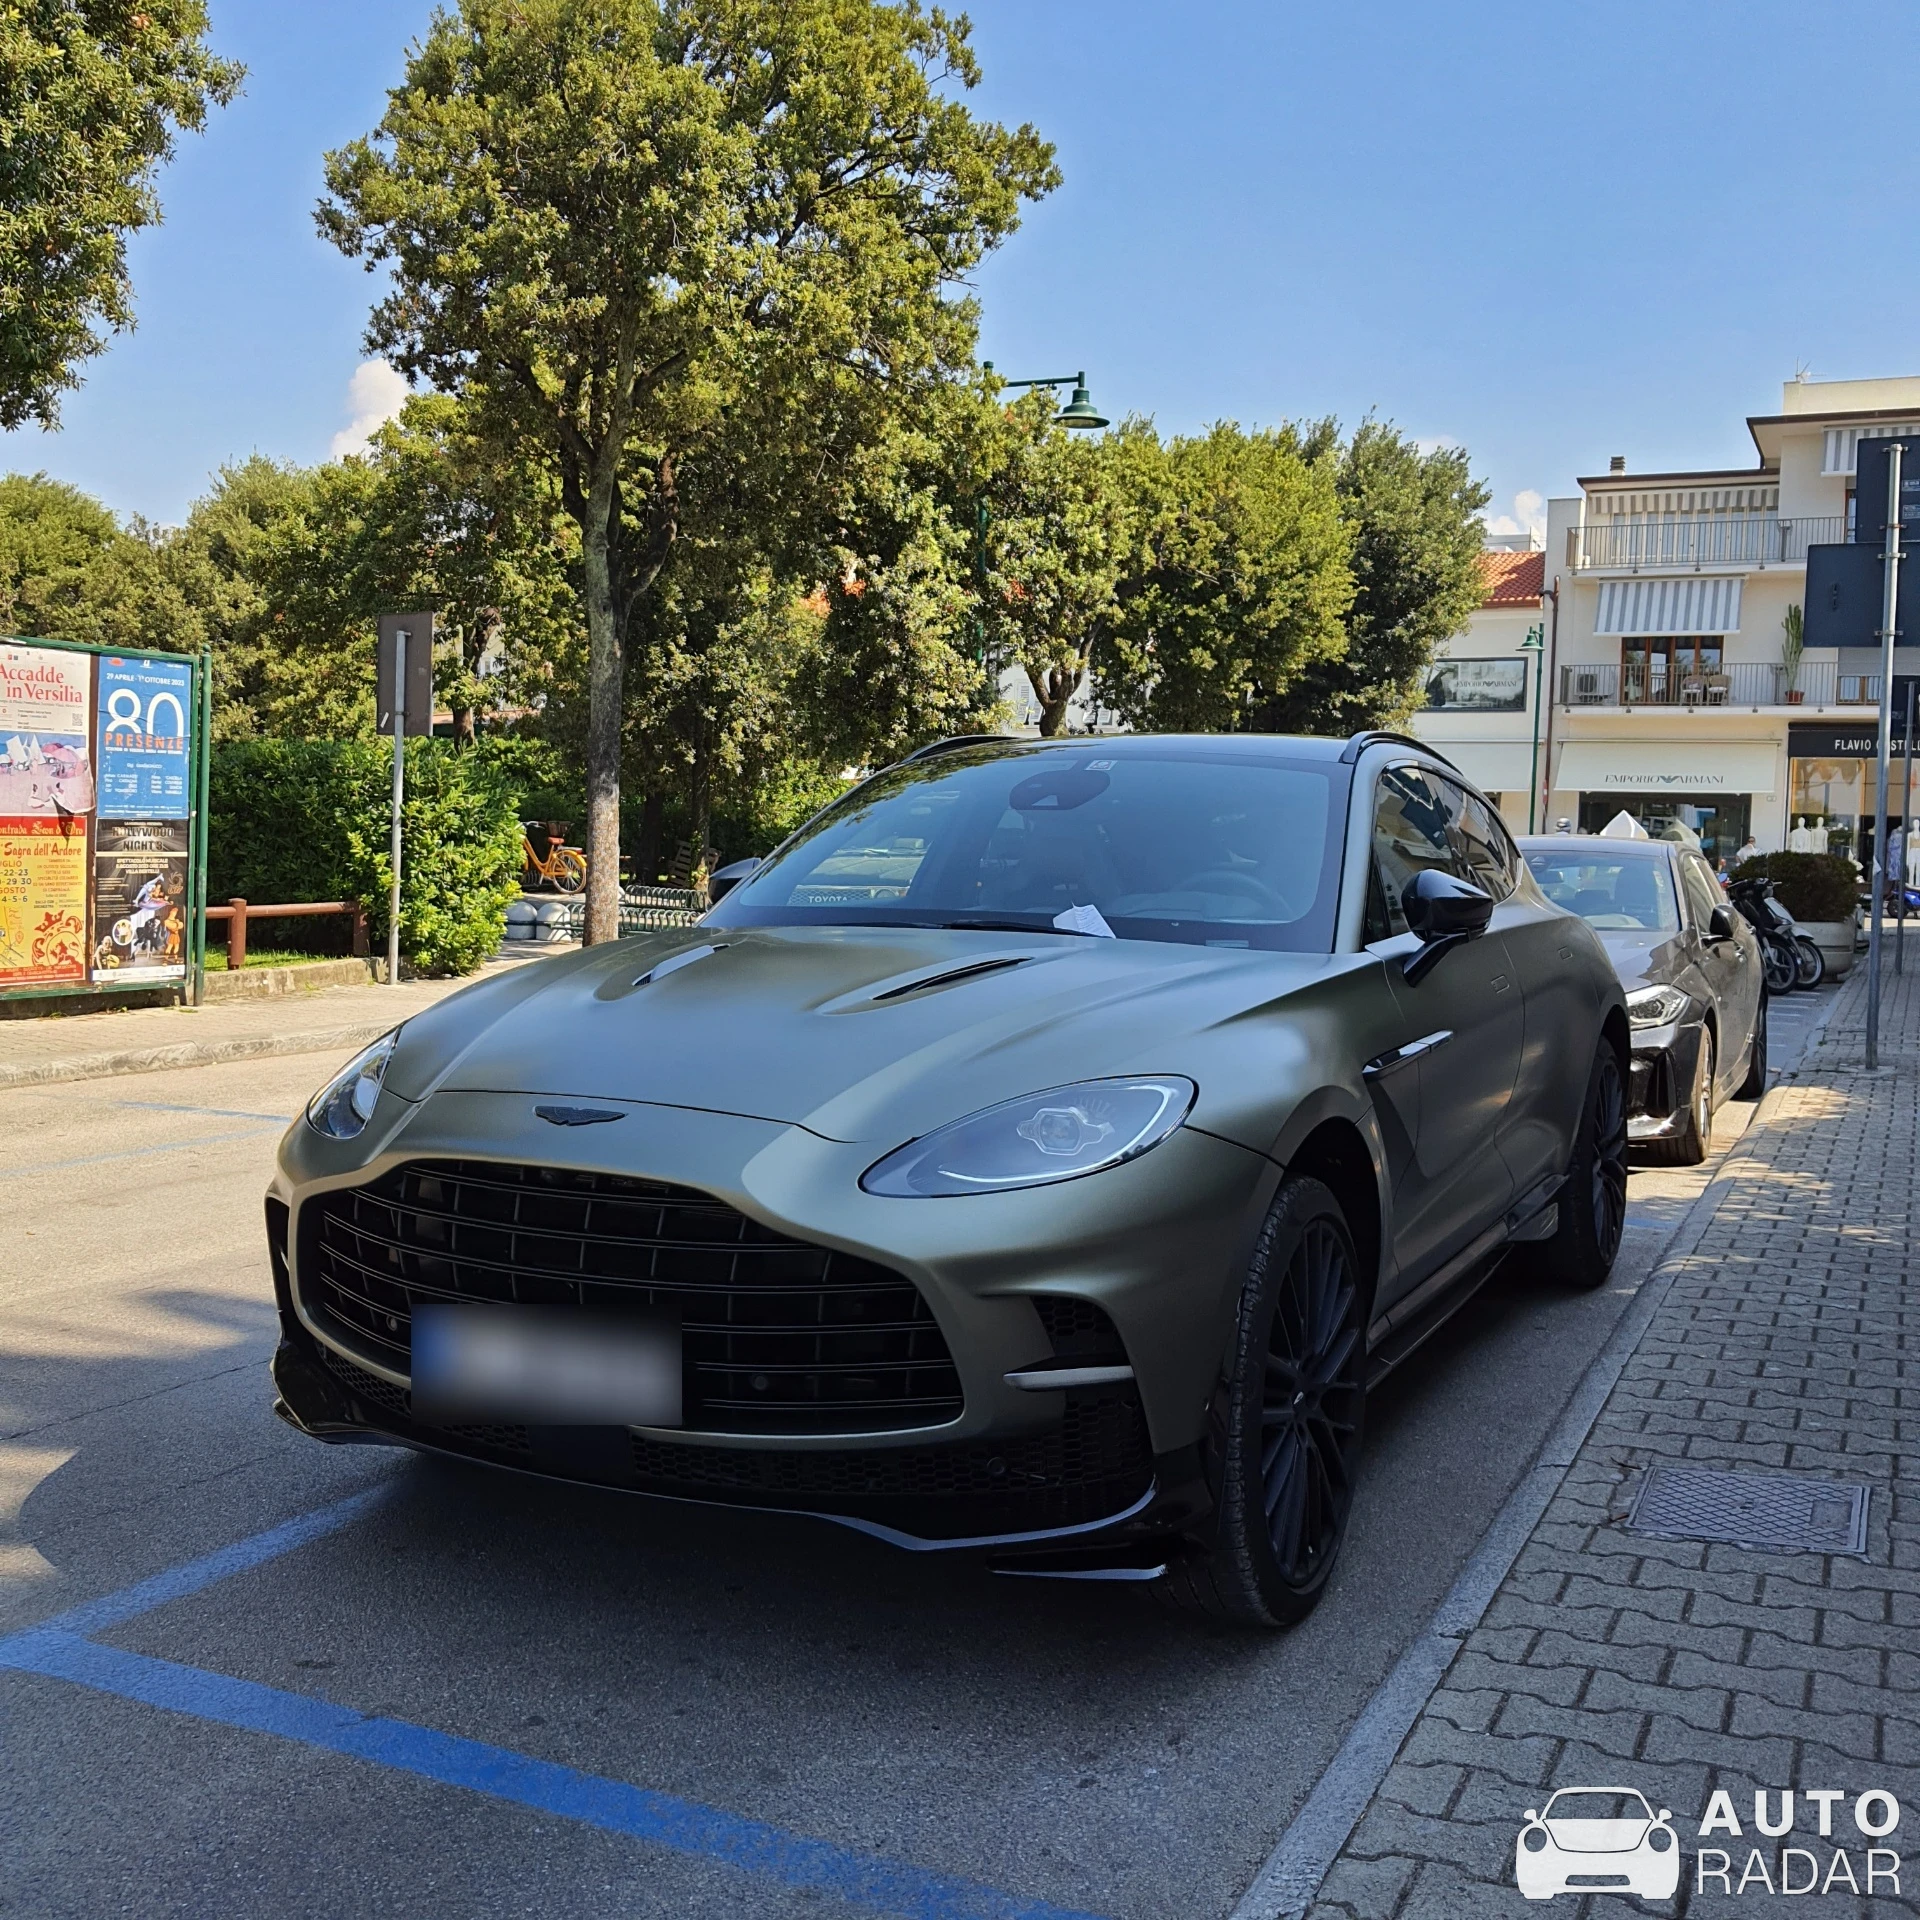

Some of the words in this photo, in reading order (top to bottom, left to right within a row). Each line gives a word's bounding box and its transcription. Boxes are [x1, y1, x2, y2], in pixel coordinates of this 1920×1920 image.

[0, 663, 64, 683] Accadde
[106, 672, 114, 680] 29
[114, 673, 134, 681] APRILE
[144, 676, 171, 685] OTTOBRE
[6, 681, 22, 698] in
[24, 682, 83, 703] Versilia
[105, 688, 184, 738] 80
[104, 732, 184, 751] PRESENZE
[1834, 739, 1872, 751] FLAVIO
[1876, 739, 1920, 751] STLL
[1605, 774, 1660, 784] EMPORIO
[1678, 775, 1724, 784] ARMANI
[112, 826, 174, 837] HOLLYWOOD
[4, 842, 31, 858] Sagra
[34, 842, 82, 856] dell'Ardore
[123, 840, 153, 851] NIGHT
[0, 860, 22, 868] GLIO
